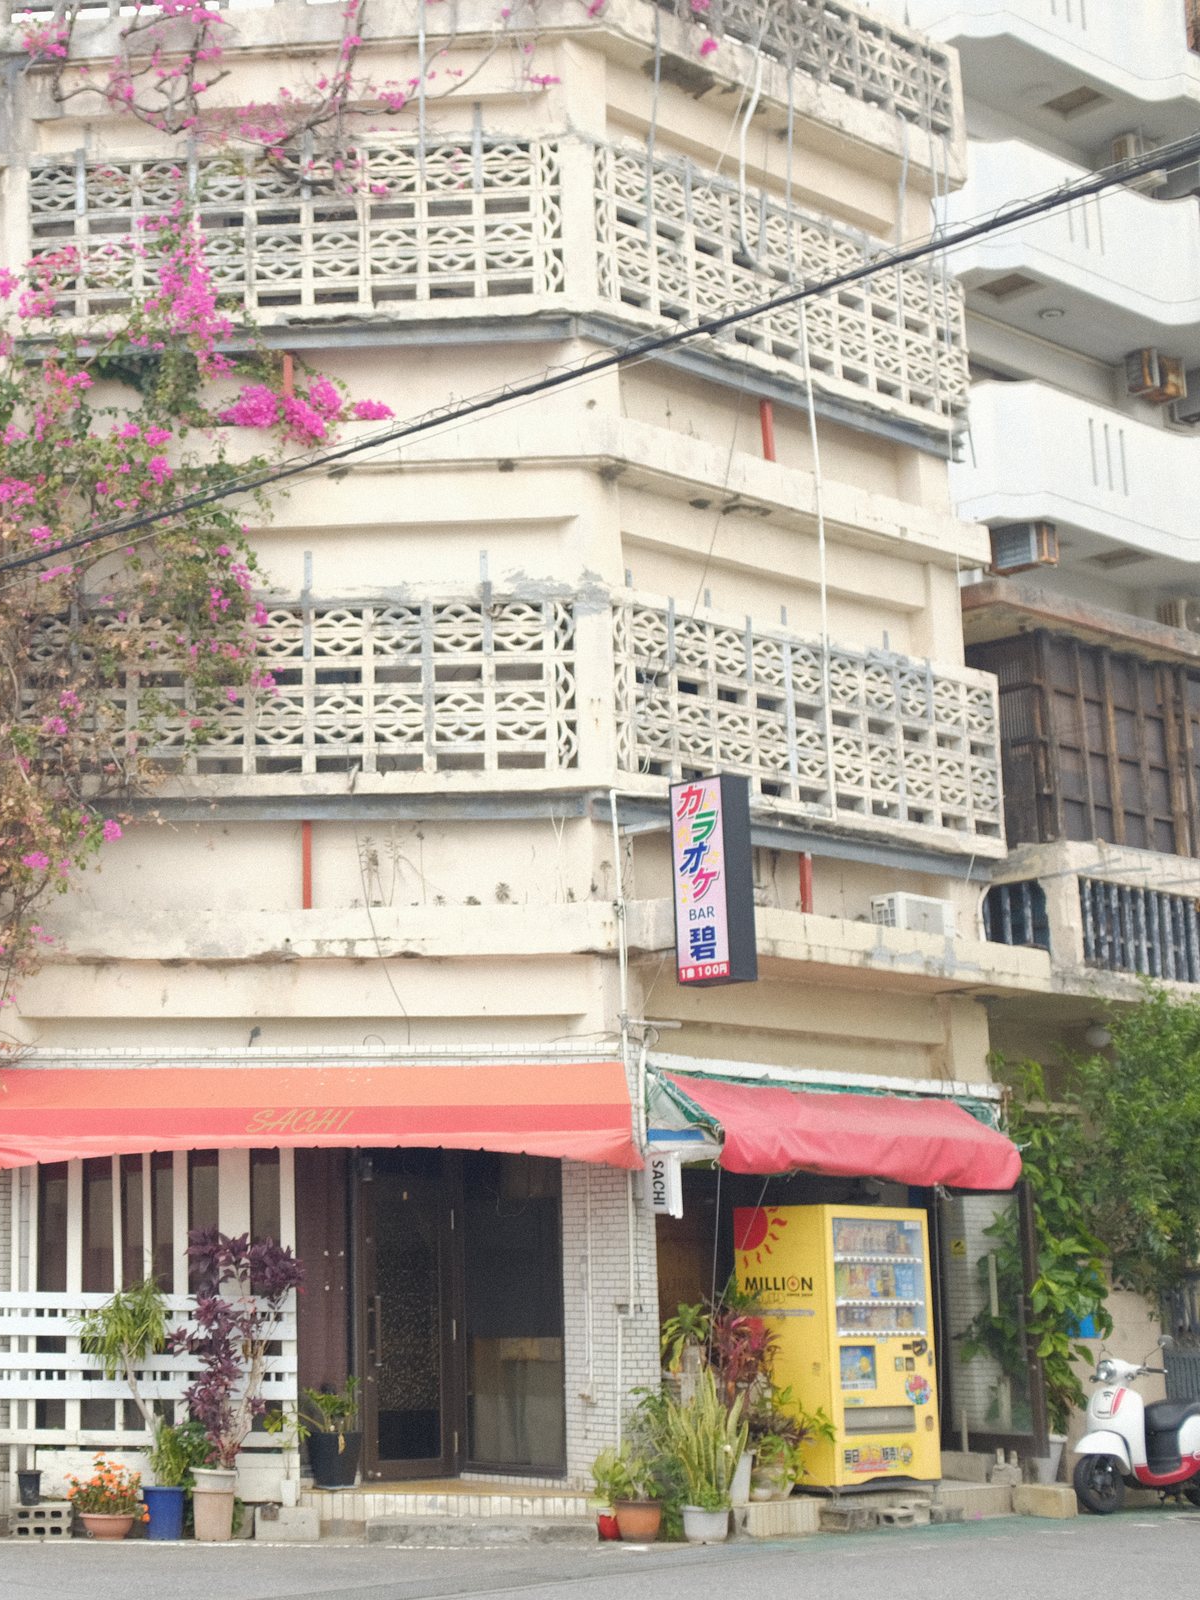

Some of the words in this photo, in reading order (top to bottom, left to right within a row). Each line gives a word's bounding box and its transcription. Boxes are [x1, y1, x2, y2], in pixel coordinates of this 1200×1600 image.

[676, 785, 718, 900] カラオケ
[689, 905, 715, 921] BAR
[689, 926, 717, 962] 碧
[246, 1108, 355, 1133] SACHI
[652, 1160, 666, 1205] SACHI
[745, 1275, 813, 1292] MILLION
